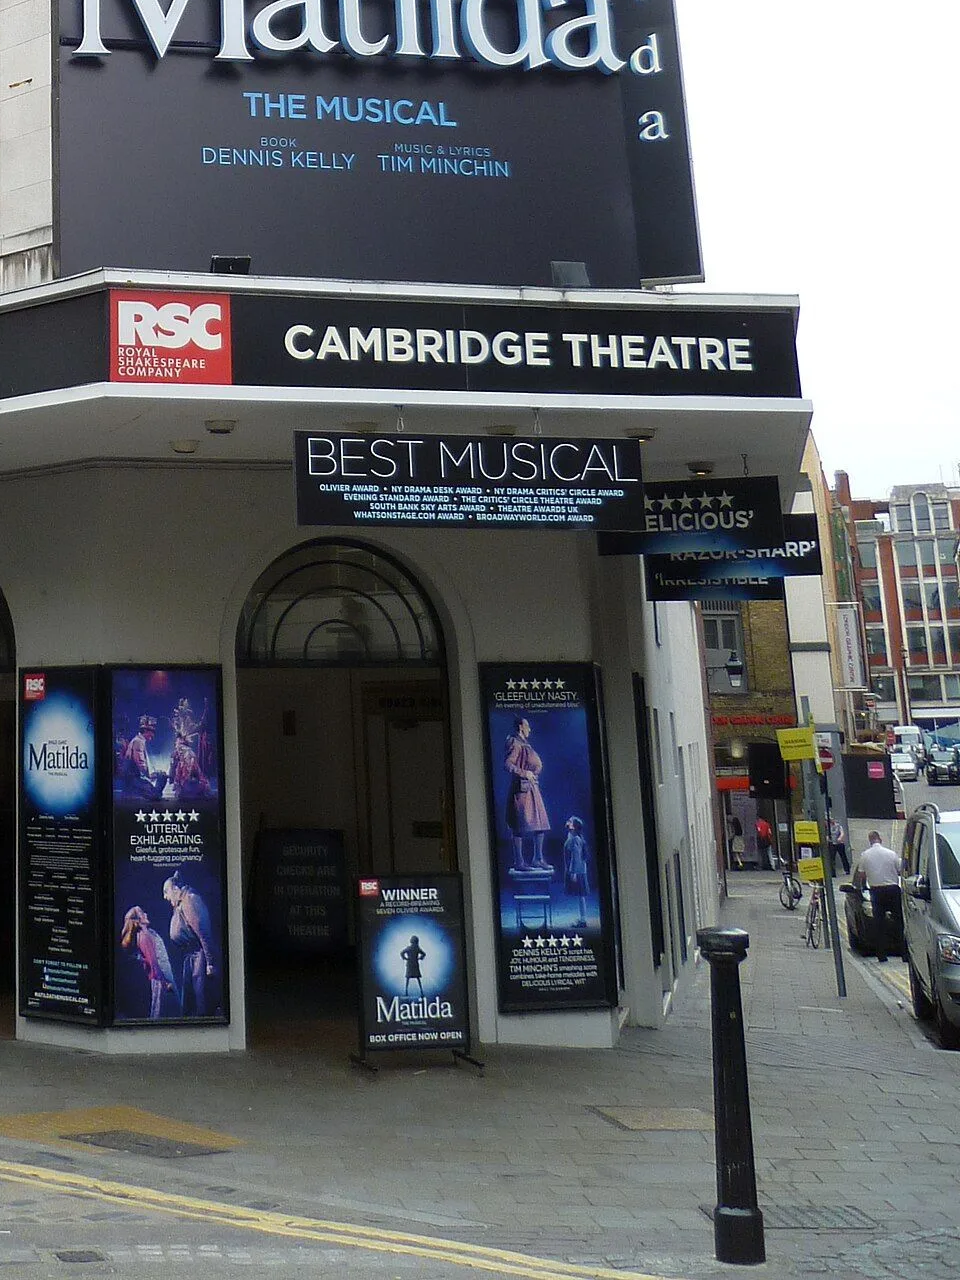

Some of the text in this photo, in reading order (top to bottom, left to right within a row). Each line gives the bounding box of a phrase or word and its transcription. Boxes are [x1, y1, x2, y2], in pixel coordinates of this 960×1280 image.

[243, 92, 457, 128] THE MUSICAL
[260, 138, 297, 149] BOOK
[394, 143, 491, 158] MUSIC & LYRICS
[201, 146, 355, 172] DENNIS KELLY
[378, 154, 511, 179] TIM MINCHIN
[117, 300, 223, 351] RSC
[118, 347, 157, 358] ROYAL
[284, 324, 753, 372] CAMBRIDGE THEATRE
[118, 356, 206, 369] SHAKESPEARE
[118, 366, 182, 378] COMPANY
[307, 437, 639, 482] BEST MUSICAL
[319, 484, 350, 492] OLIVIER
[391, 485, 403, 493] NY
[404, 486, 432, 494] DRAMA
[433, 486, 453, 494] DESK
[455, 486, 482, 494] AWARD
[494, 487, 506, 495] NY
[597, 489, 624, 497] AWARD
[344, 493, 377, 501] EVENING
[379, 494, 420, 502] STANDARD
[511, 496, 538, 504] CIRCLE
[540, 497, 573, 505] THEATRE
[575, 497, 602, 505] AWARD
[397, 503, 419, 511] BANK
[497, 505, 531, 513] THEATRE
[533, 505, 566, 513] AWARDS
[353, 511, 594, 522] WHATSONSTAGE.COM AWARD BROADWAYWORLD.COM AWARD
[645, 510, 754, 532] ELICIOUS'
[29, 743, 89, 772] Matilda
[130, 835, 203, 845] EXHILARATING.
[361, 882, 438, 901] RSC WINNER
[376, 996, 453, 1023] Matilda
[388, 1033, 417, 1042] OFFICE
[418, 1032, 439, 1040] NOW
[440, 1031, 462, 1039] OPEN
